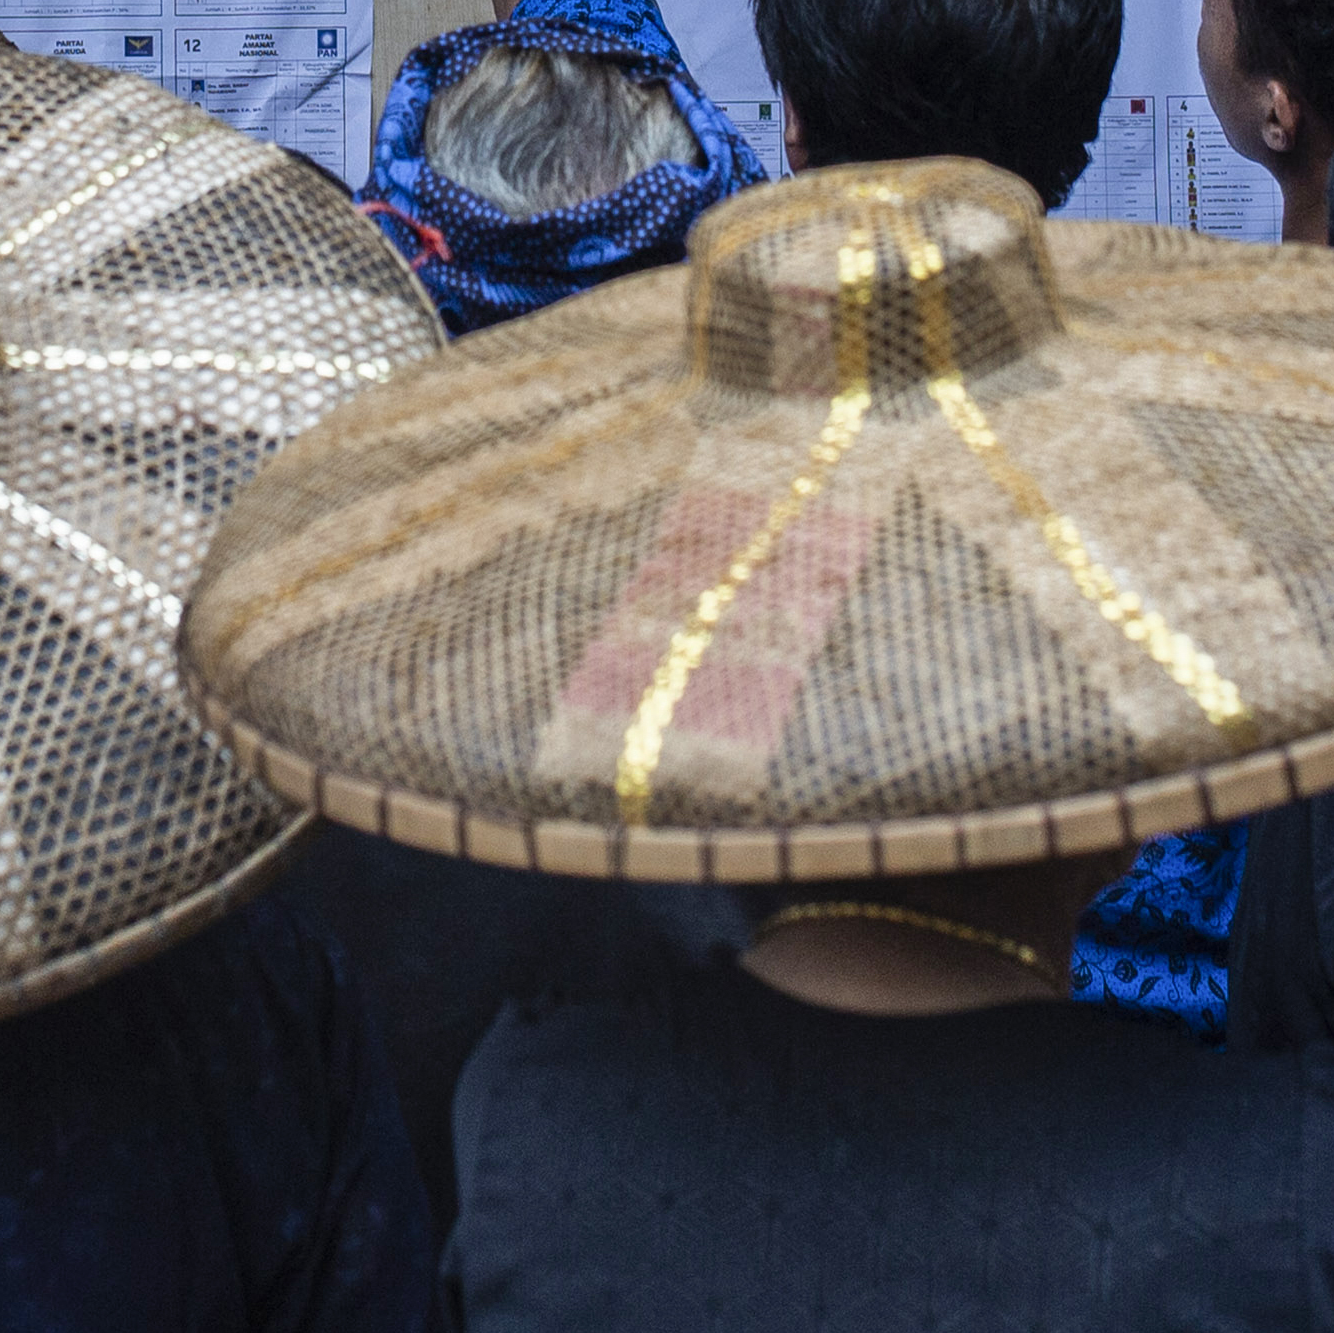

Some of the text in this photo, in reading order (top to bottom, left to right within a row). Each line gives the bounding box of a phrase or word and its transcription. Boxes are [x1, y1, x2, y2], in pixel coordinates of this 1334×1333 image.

[245, 33, 273, 41] PARTAI
[184, 39, 201, 52] 12
[1180, 101, 1188, 111] 4
